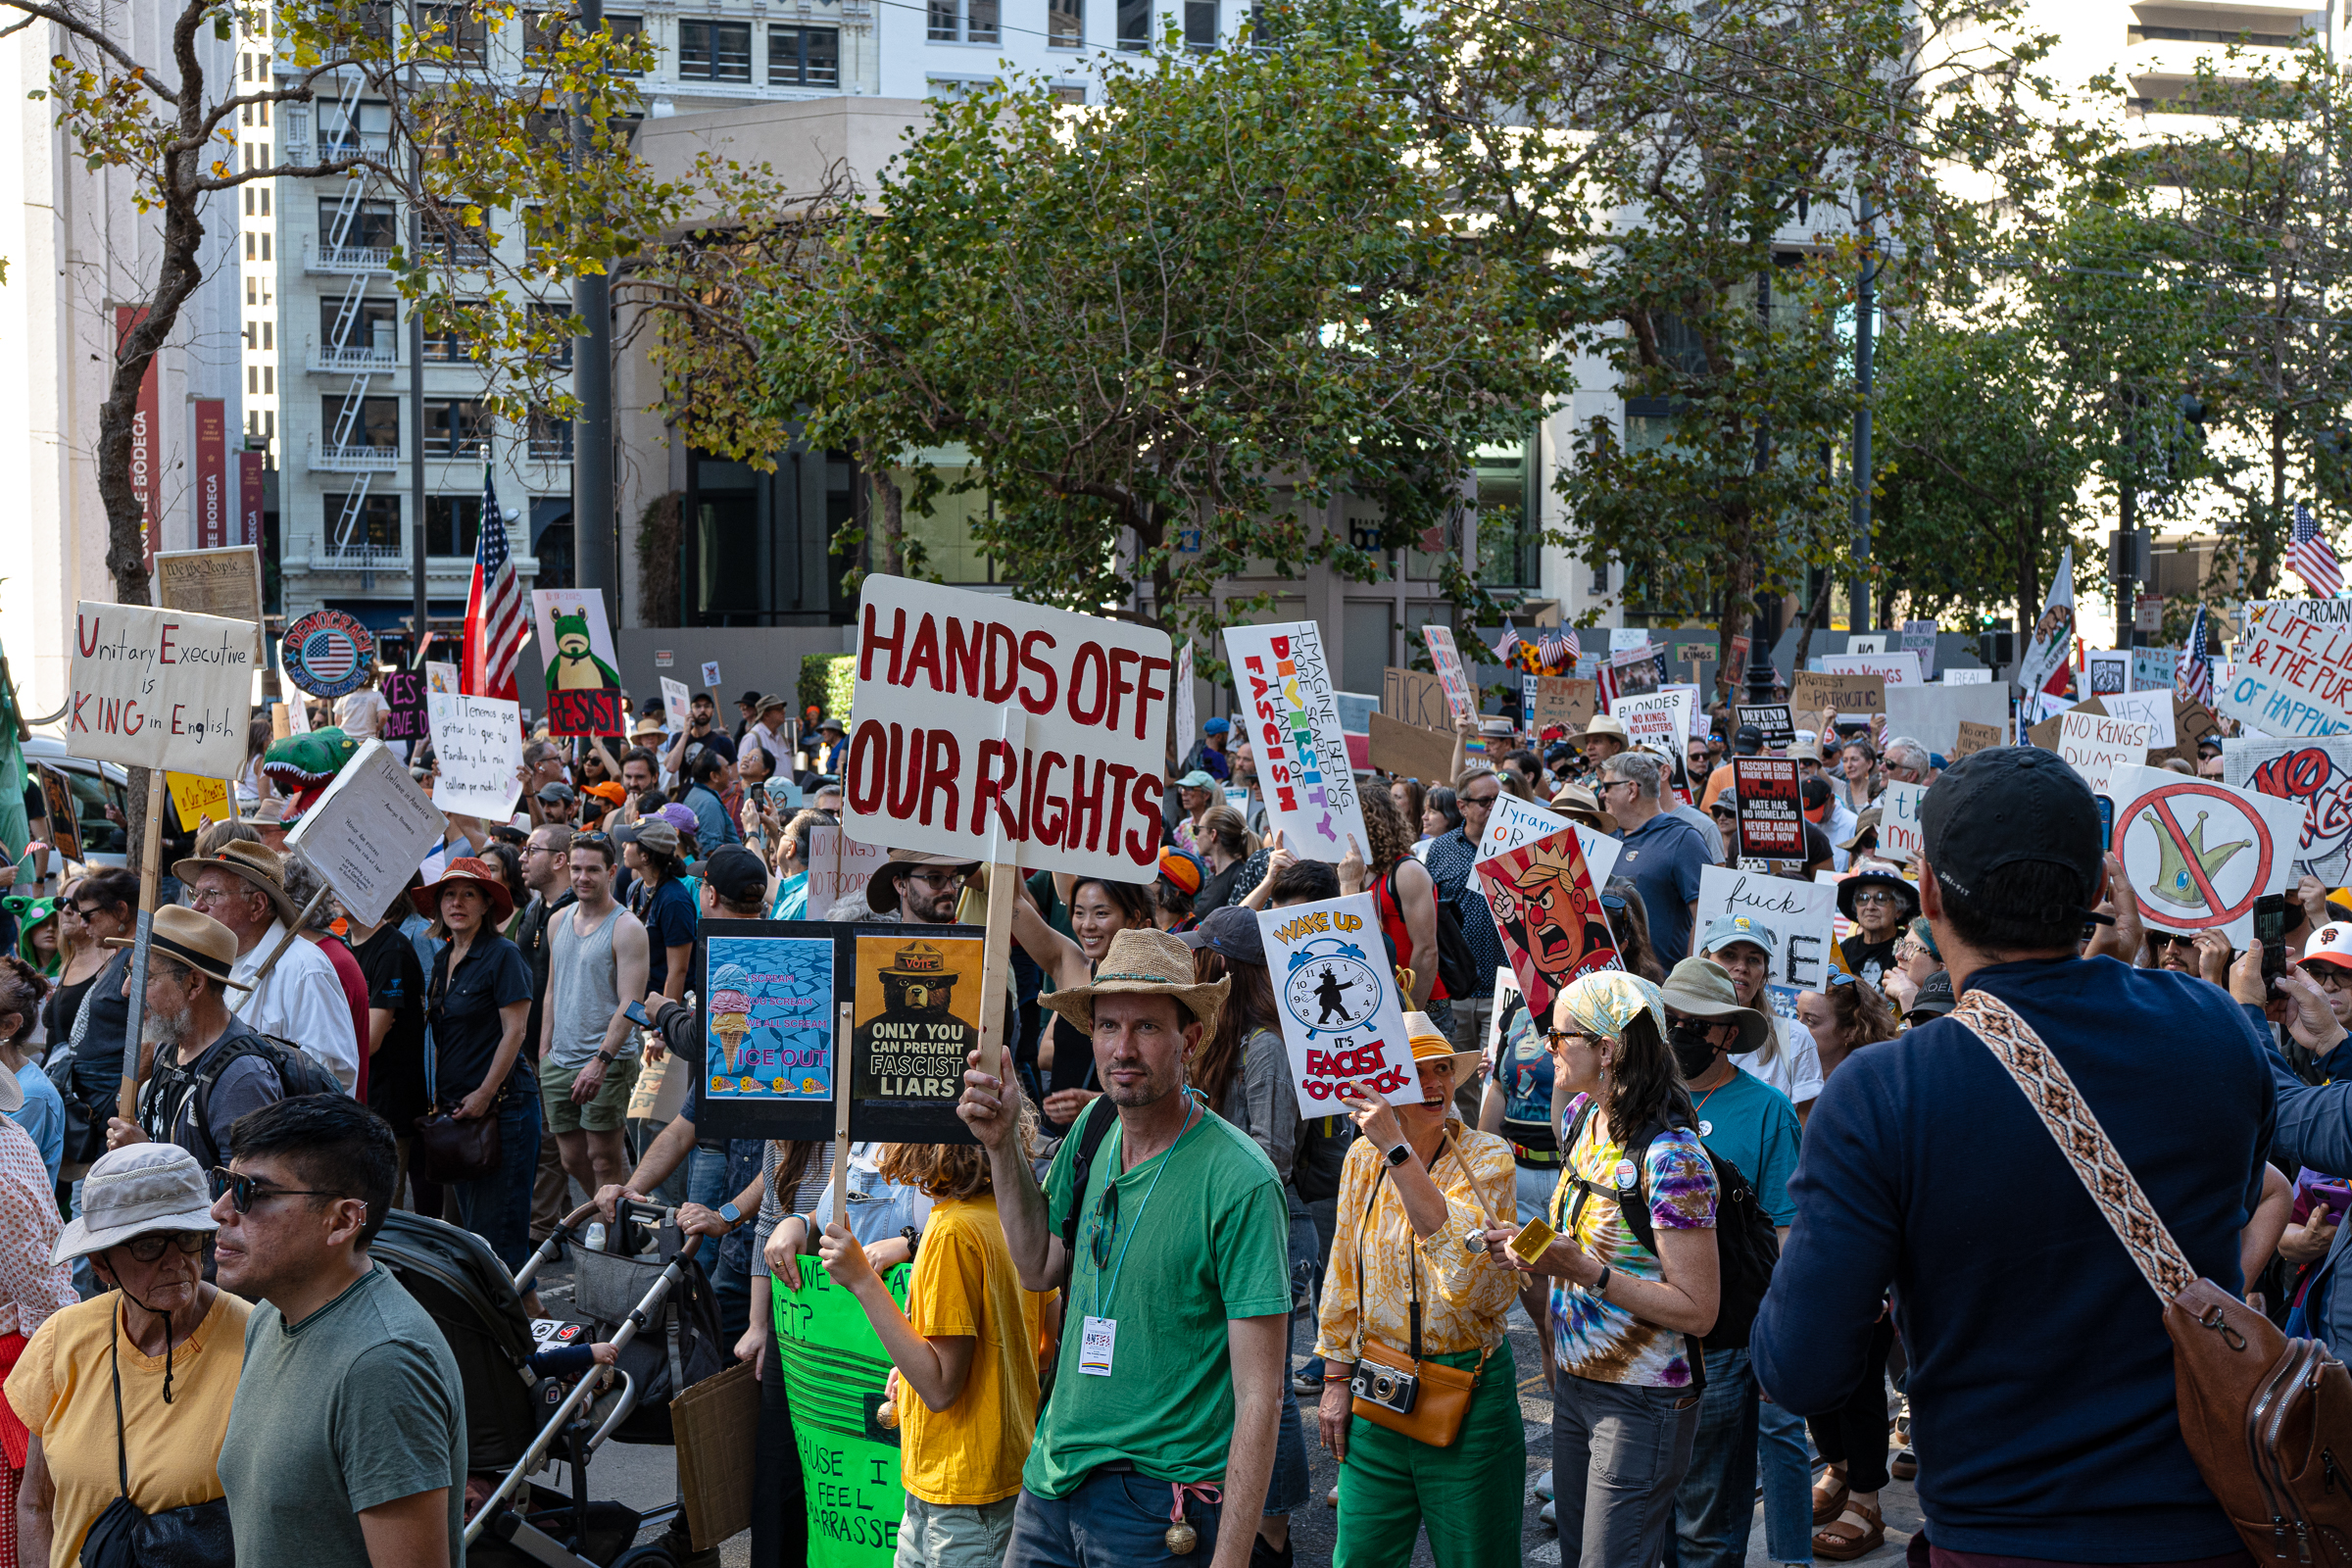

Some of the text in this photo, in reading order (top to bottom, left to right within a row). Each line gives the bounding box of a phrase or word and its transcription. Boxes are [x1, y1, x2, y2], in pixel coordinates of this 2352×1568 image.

[132, 410, 147, 487] BODEGA
[207, 474, 218, 529] BODEGA
[201, 557, 238, 575] People
[78, 613, 246, 673] Unitary Executive
[286, 612, 373, 653] DEMOCRACY
[2266, 609, 2323, 658] LIFE,
[1683, 651, 1711, 661] KINGS
[2135, 649, 2168, 662] BRO IS
[2248, 639, 2269, 668] &
[2269, 645, 2319, 688] THE
[290, 664, 313, 687] NOT
[859, 603, 1058, 715] HANDS
[1067, 640, 1172, 741] OFF
[1796, 672, 1844, 687] PROTEST
[2154, 666, 2169, 680] THE
[141, 679, 155, 694] is
[382, 671, 417, 706] YES
[1538, 676, 1592, 698] DRUMPF
[2234, 677, 2268, 708] OF
[1386, 671, 1435, 727] FUCK
[1549, 696, 1565, 706] IS
[1814, 690, 1877, 708] PATRIOTIC
[71, 690, 233, 743] KING in English
[502, 711, 514, 725] que
[549, 689, 621, 732] RESIST
[1298, 622, 1354, 808] IMAGINE BEING
[1632, 711, 1666, 723] NO KINGS
[1740, 708, 1788, 721] DEFUND
[443, 722, 508, 745] gritar lo que tu
[1245, 656, 1298, 812] FASCISM
[1268, 676, 1305, 790] THAN OF
[1288, 636, 1343, 815] MORE SCARED OF
[1630, 721, 1674, 735] NO MASTERS
[1960, 723, 1999, 741] No one is
[2064, 714, 2090, 739] NO
[2097, 718, 2146, 747] KINGS
[1270, 635, 1337, 843] DIVERSITY
[471, 756, 476, 769] y
[479, 749, 486, 762] la
[1739, 760, 1793, 772] FASCISM ENDS
[445, 776, 466, 791] callan
[1740, 770, 1762, 779] WHERE
[2254, 747, 2332, 800] NO
[384, 768, 405, 795] believe
[404, 790, 410, 801] in
[848, 719, 1164, 866] OUR RIGHTS
[1742, 809, 1797, 820] NO HOMELAND
[1748, 800, 1788, 810] HATE HAS
[1744, 821, 1798, 833] NEVER AGAIN
[1748, 831, 1795, 842] MEANS NOW
[365, 841, 380, 857] process
[811, 833, 876, 857] NO KNGS
[809, 872, 823, 896] NO
[1940, 871, 1970, 896] DRI-FIT
[1725, 876, 1805, 914] fuck
[1273, 911, 1362, 946] WAKE UP
[906, 958, 933, 968] VOTE
[1305, 969, 1315, 978] 11
[751, 974, 794, 983] SCREAM
[1296, 980, 1307, 990] 10
[745, 997, 812, 1005] YOU SCREAM
[763, 1019, 782, 1028] ALL
[784, 1019, 827, 1028] SCREAM
[872, 1022, 964, 1041] ONLY YOU
[1337, 1017, 1344, 1026] 6
[870, 1041, 964, 1054] CAN PREVENT
[1335, 1035, 1354, 1049] IT'S
[738, 1049, 827, 1066] ICE OUT
[870, 1055, 964, 1076] FASCIST
[1306, 1039, 1387, 1080] FACIST
[880, 1077, 955, 1098] LIARS
[774, 1294, 813, 1343] YET?
[870, 1458, 888, 1486] I
[818, 1482, 874, 1511] FEEL
